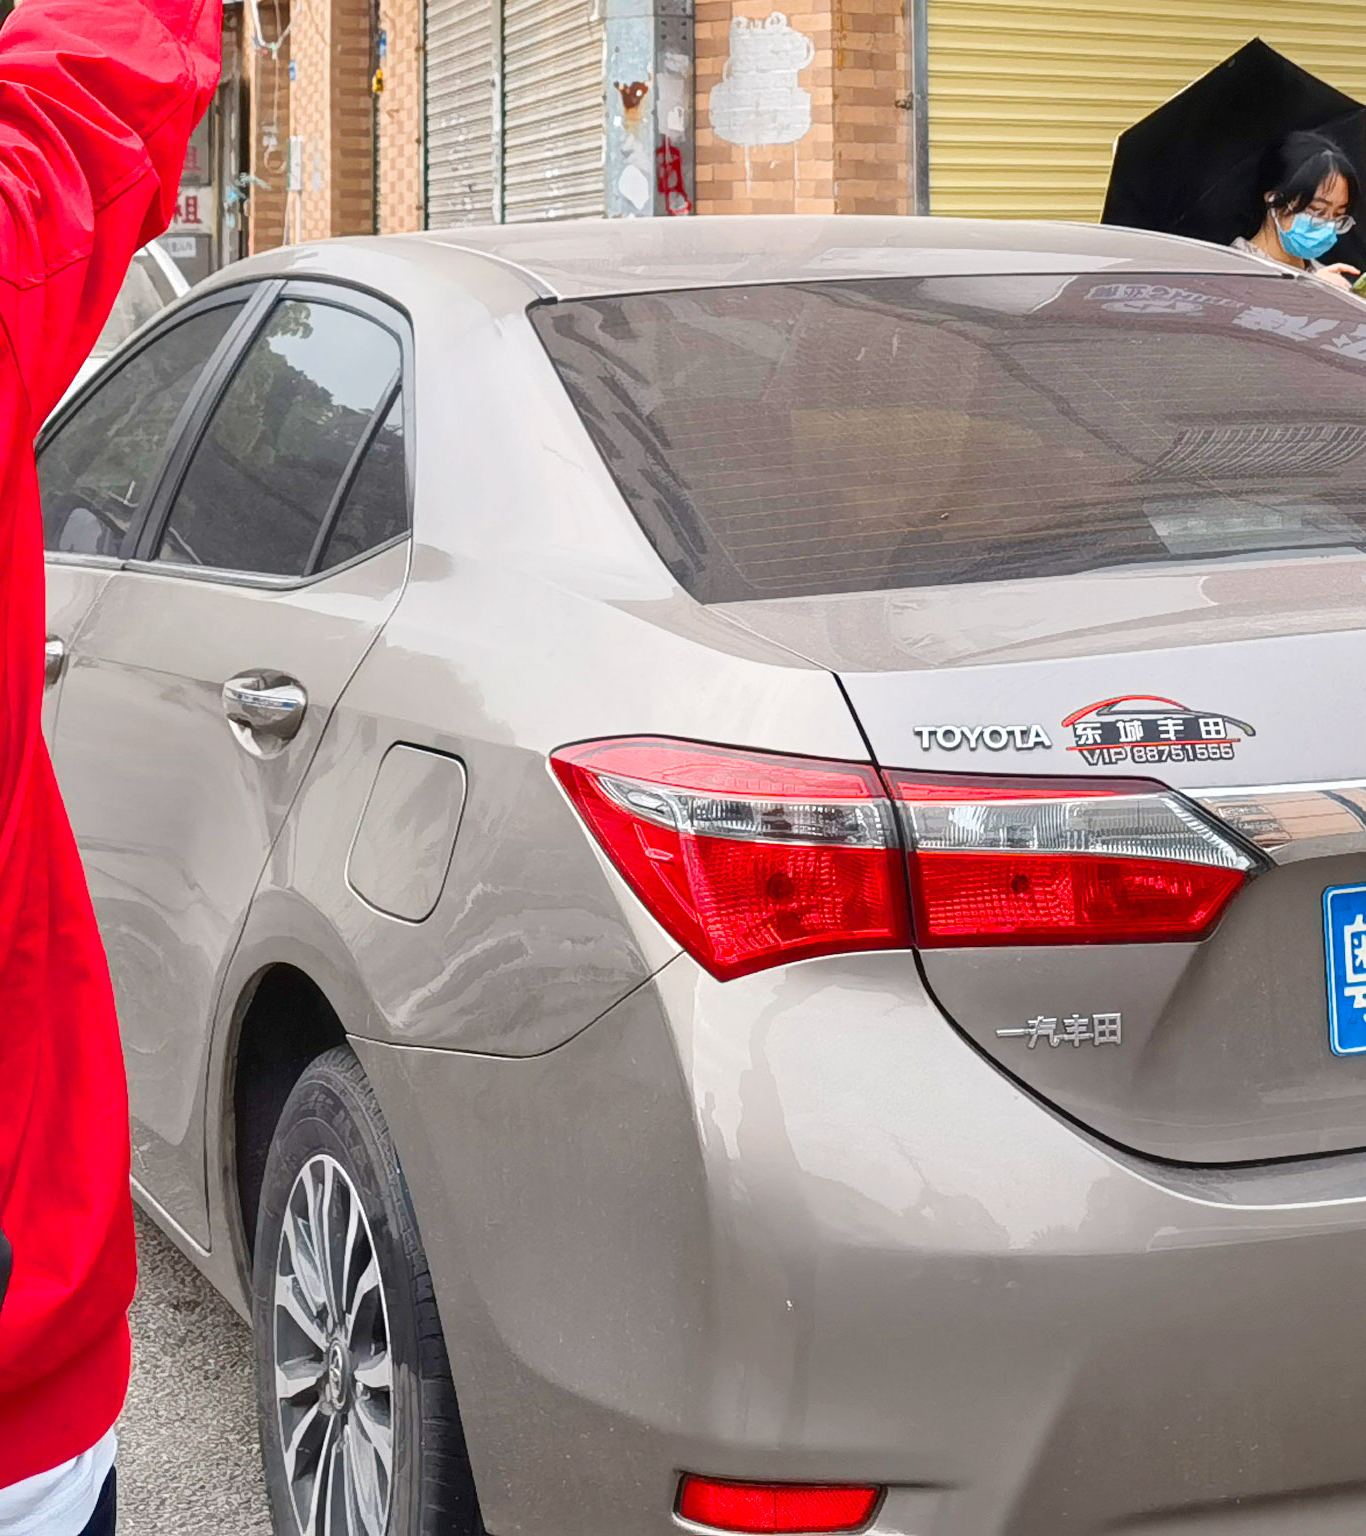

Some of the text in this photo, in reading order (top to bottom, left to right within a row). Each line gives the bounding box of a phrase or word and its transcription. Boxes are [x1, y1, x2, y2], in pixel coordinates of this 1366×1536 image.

[914, 724, 1052, 752] TOYOTA
[1073, 716, 1228, 746] 东城丰田
[1081, 747, 1127, 766] VIP
[996, 1012, 1122, 1050] 一汽丰田
